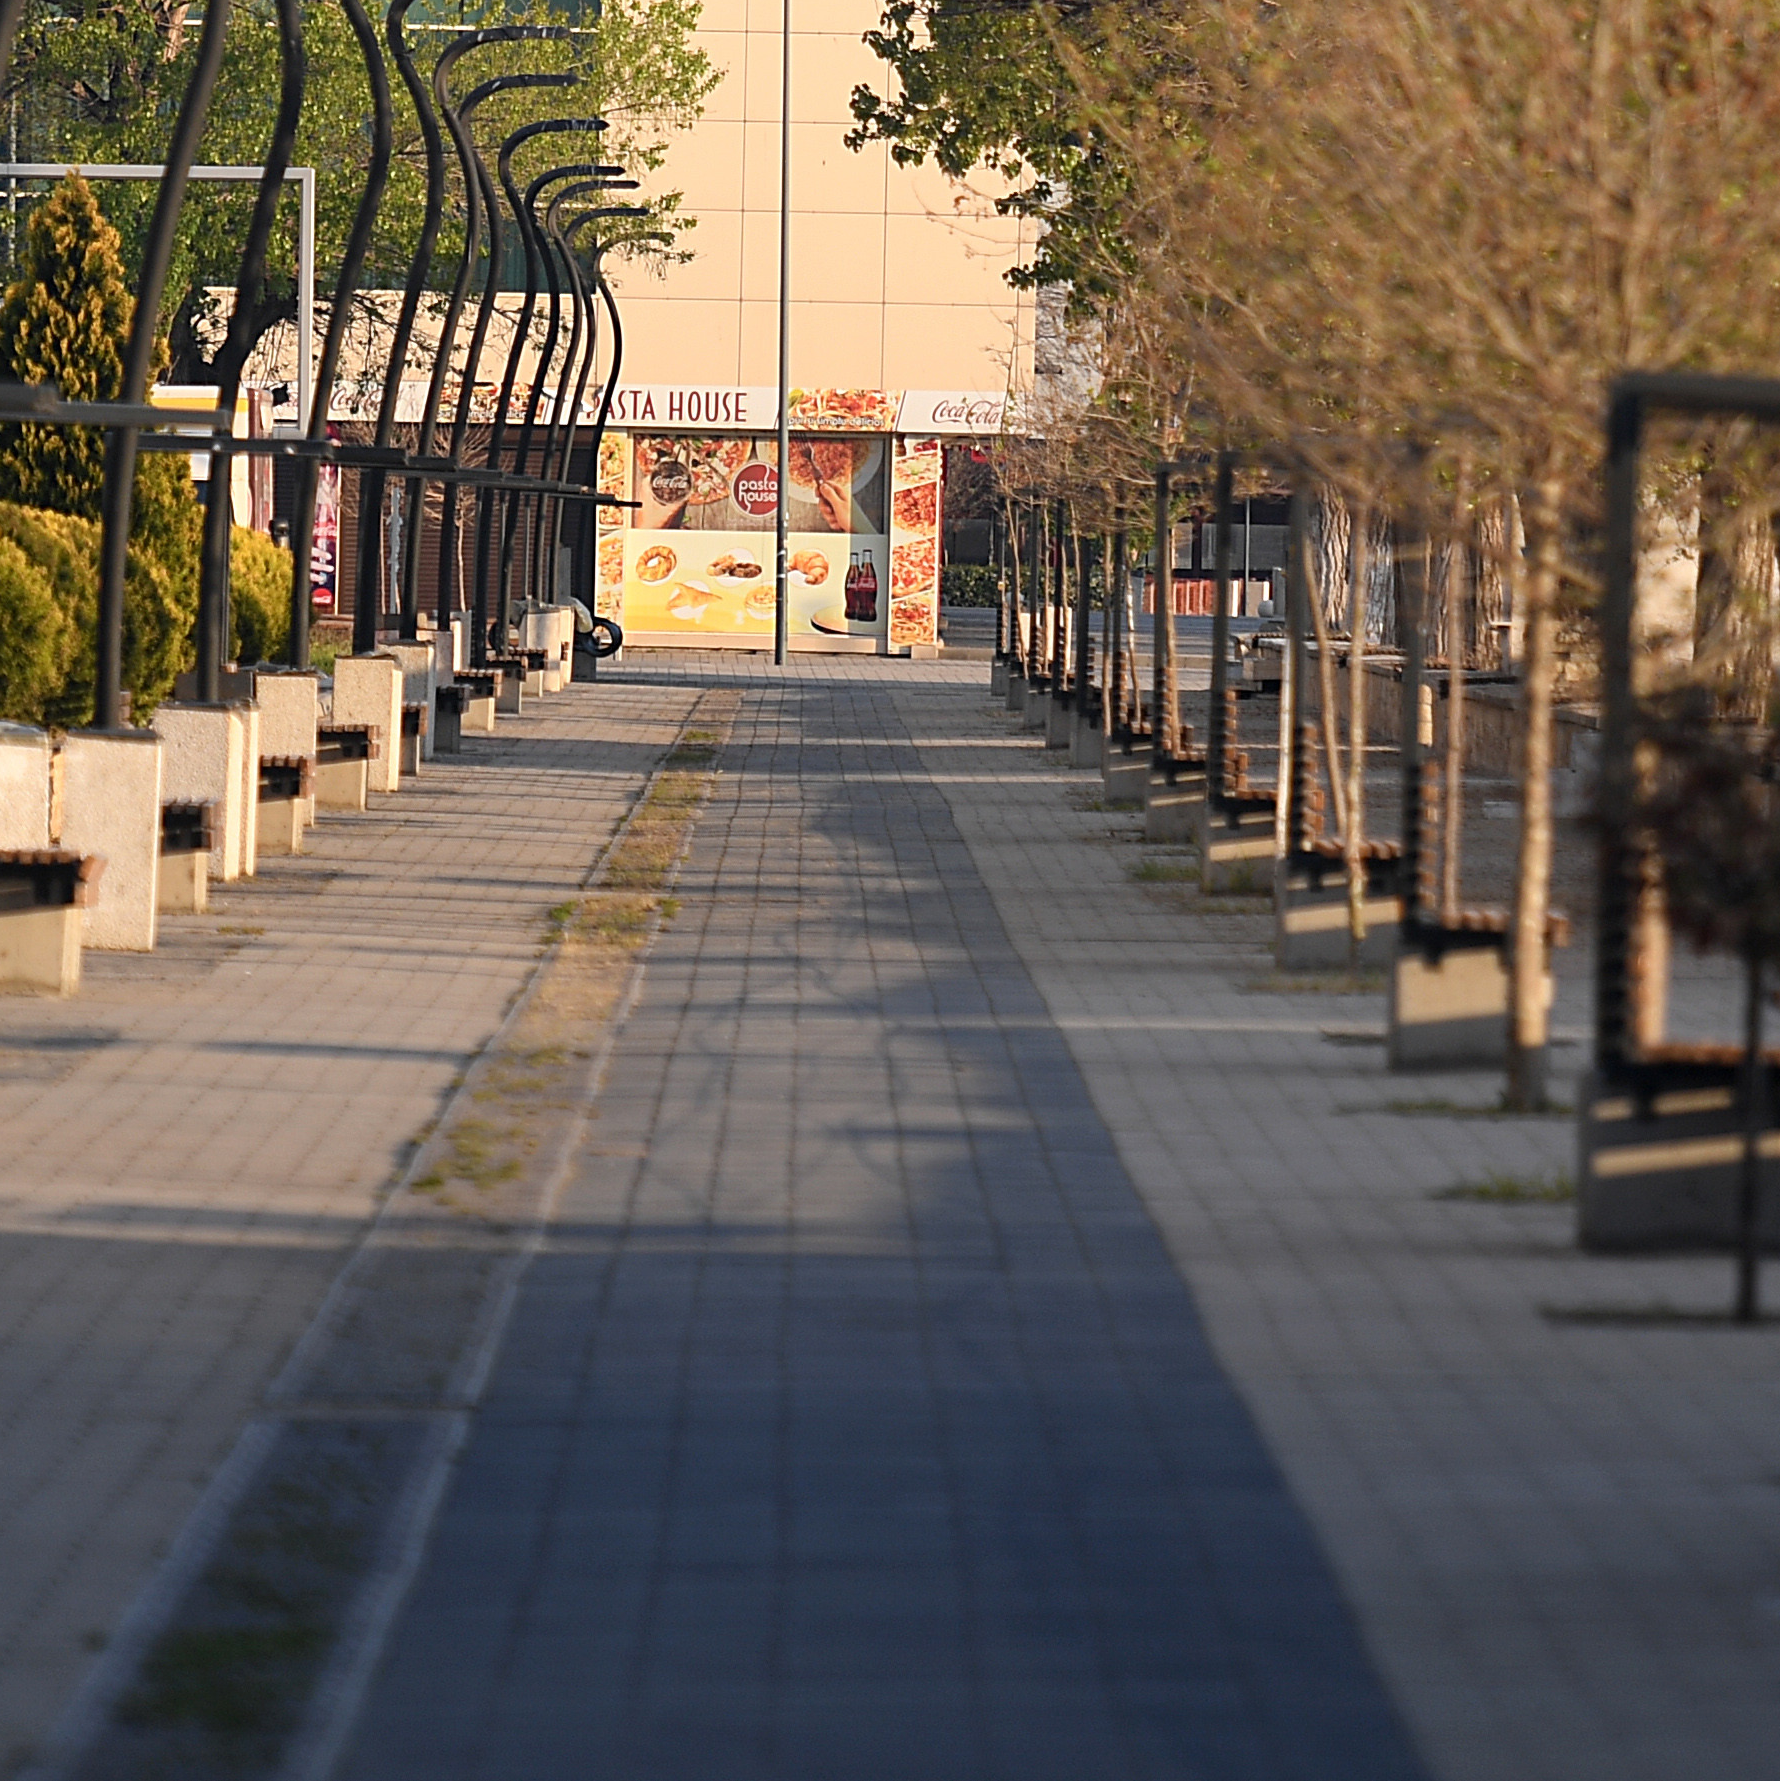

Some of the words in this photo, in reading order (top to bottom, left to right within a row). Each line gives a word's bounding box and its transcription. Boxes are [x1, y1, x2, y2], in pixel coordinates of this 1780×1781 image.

[669, 391, 748, 423] HOUSE
[739, 480, 778, 491] pasta
[739, 490, 778, 502] house
